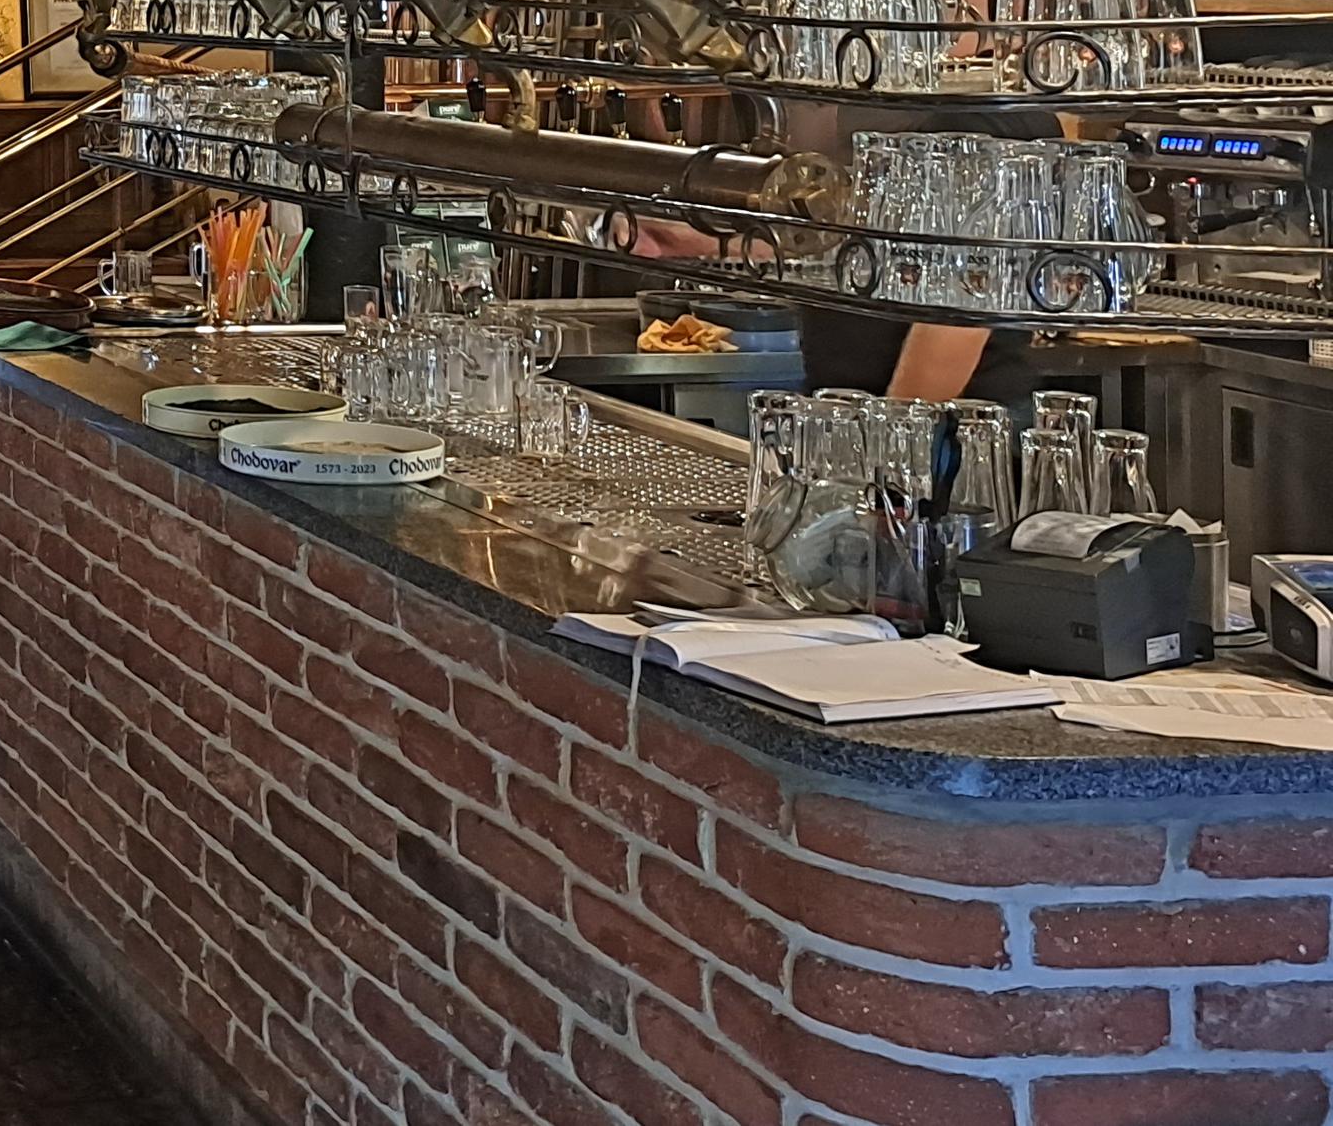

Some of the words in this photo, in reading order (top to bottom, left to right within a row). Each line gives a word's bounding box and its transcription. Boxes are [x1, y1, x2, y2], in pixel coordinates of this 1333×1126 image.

[230, 447, 299, 474] Chodovar
[314, 464, 341, 474] 1573
[351, 464, 376, 474] 2023
